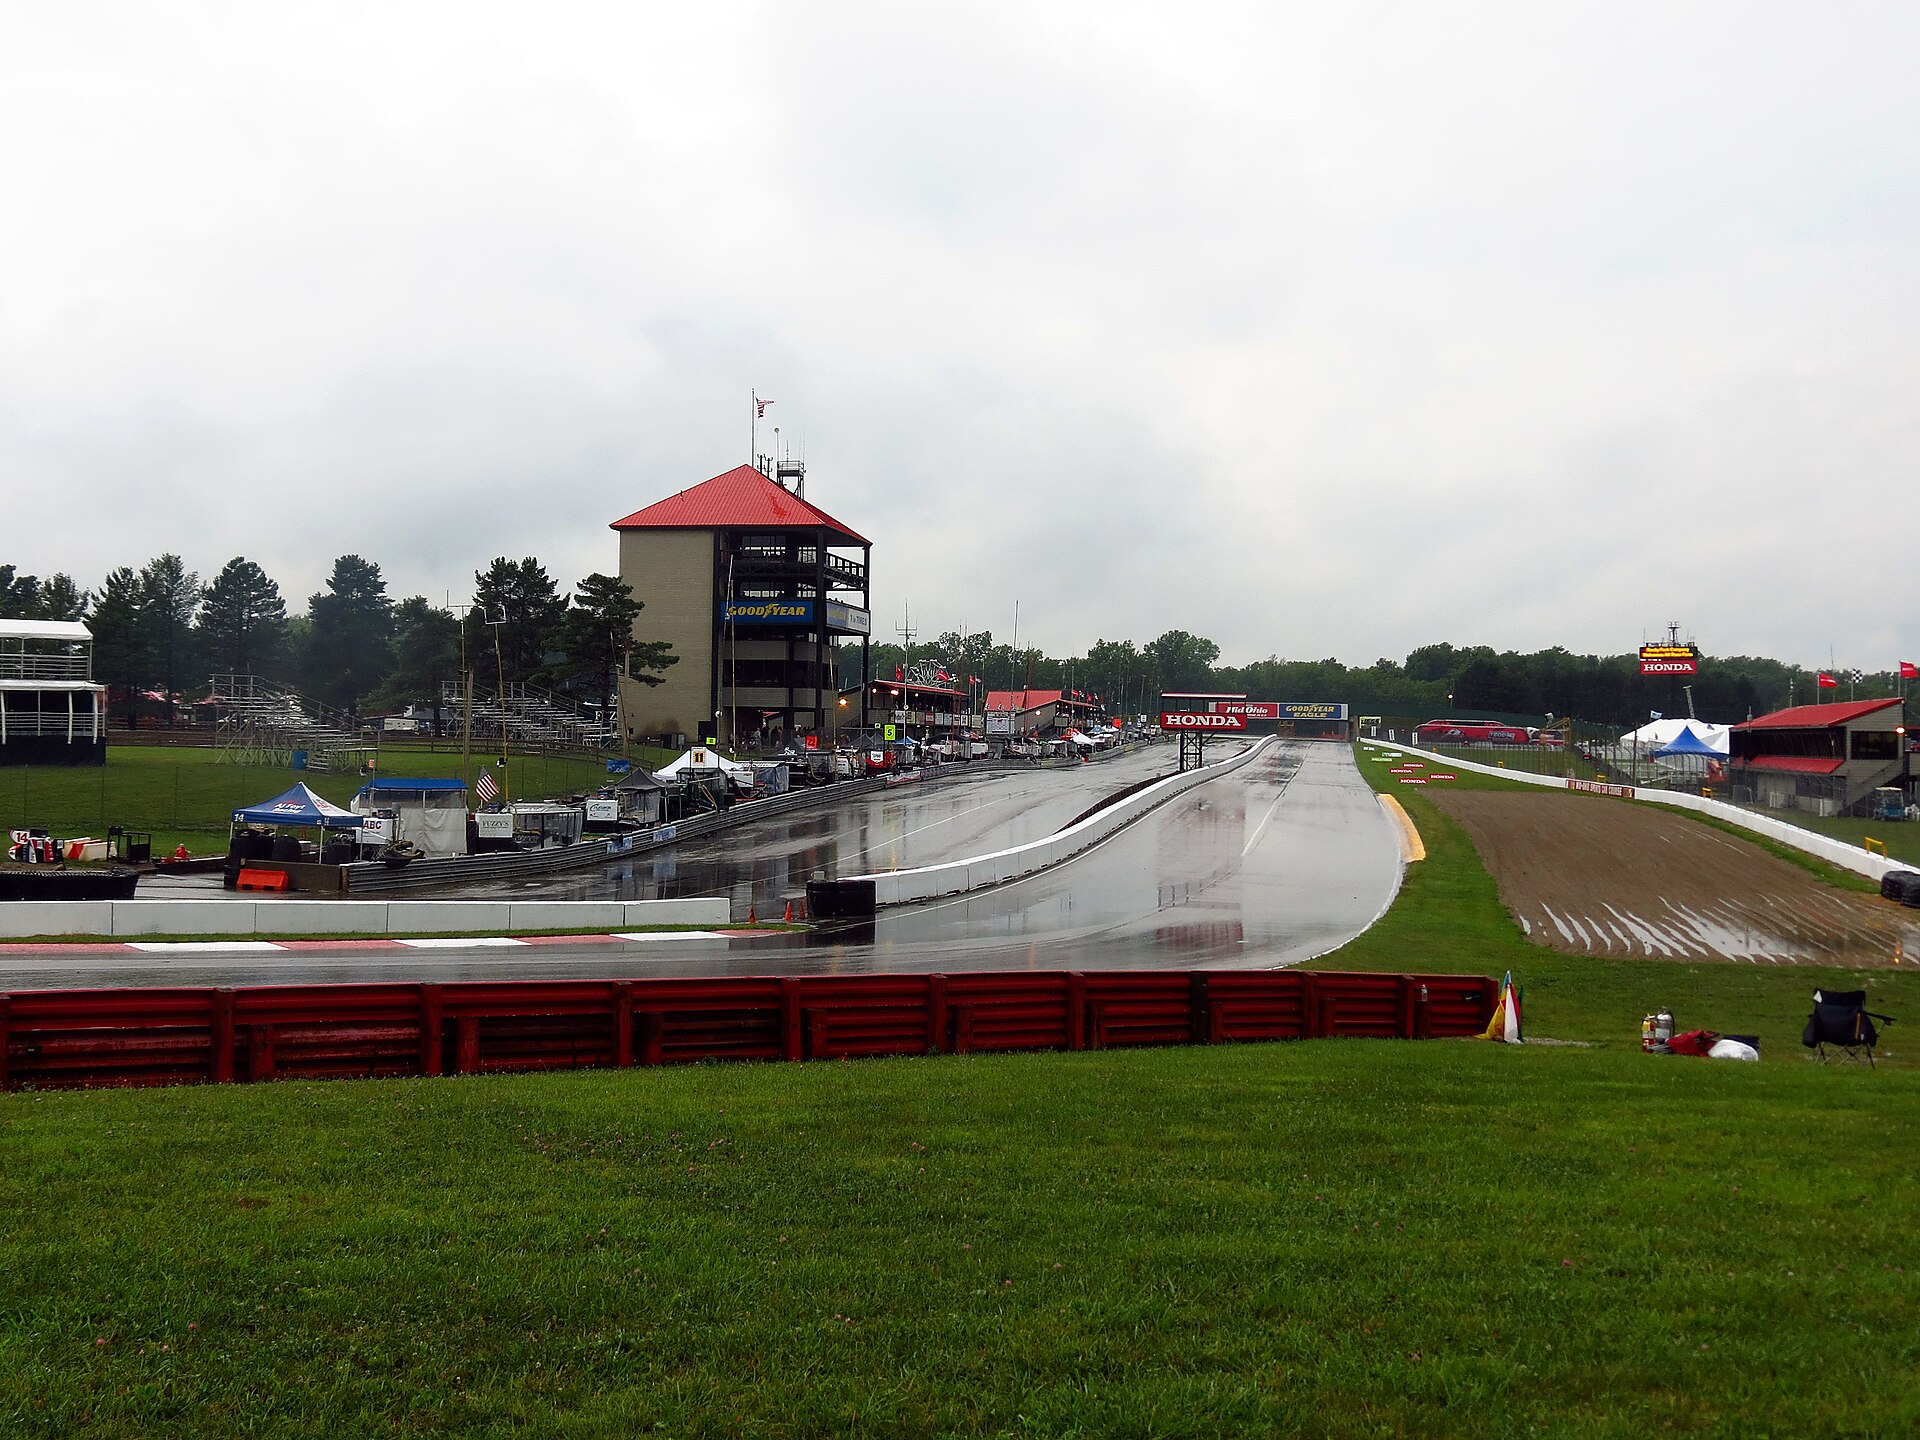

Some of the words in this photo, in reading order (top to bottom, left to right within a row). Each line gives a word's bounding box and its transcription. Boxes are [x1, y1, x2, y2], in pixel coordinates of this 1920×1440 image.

[728, 604, 806, 617] GOODYEAR
[1643, 663, 1693, 672] HONDA
[1285, 704, 1335, 712] GOODYEAR
[1165, 714, 1242, 727] HONDA
[695, 752, 704, 763] 11
[234, 813, 244, 822] 14
[363, 820, 382, 829] ABC
[16, 832, 30, 843] 14
